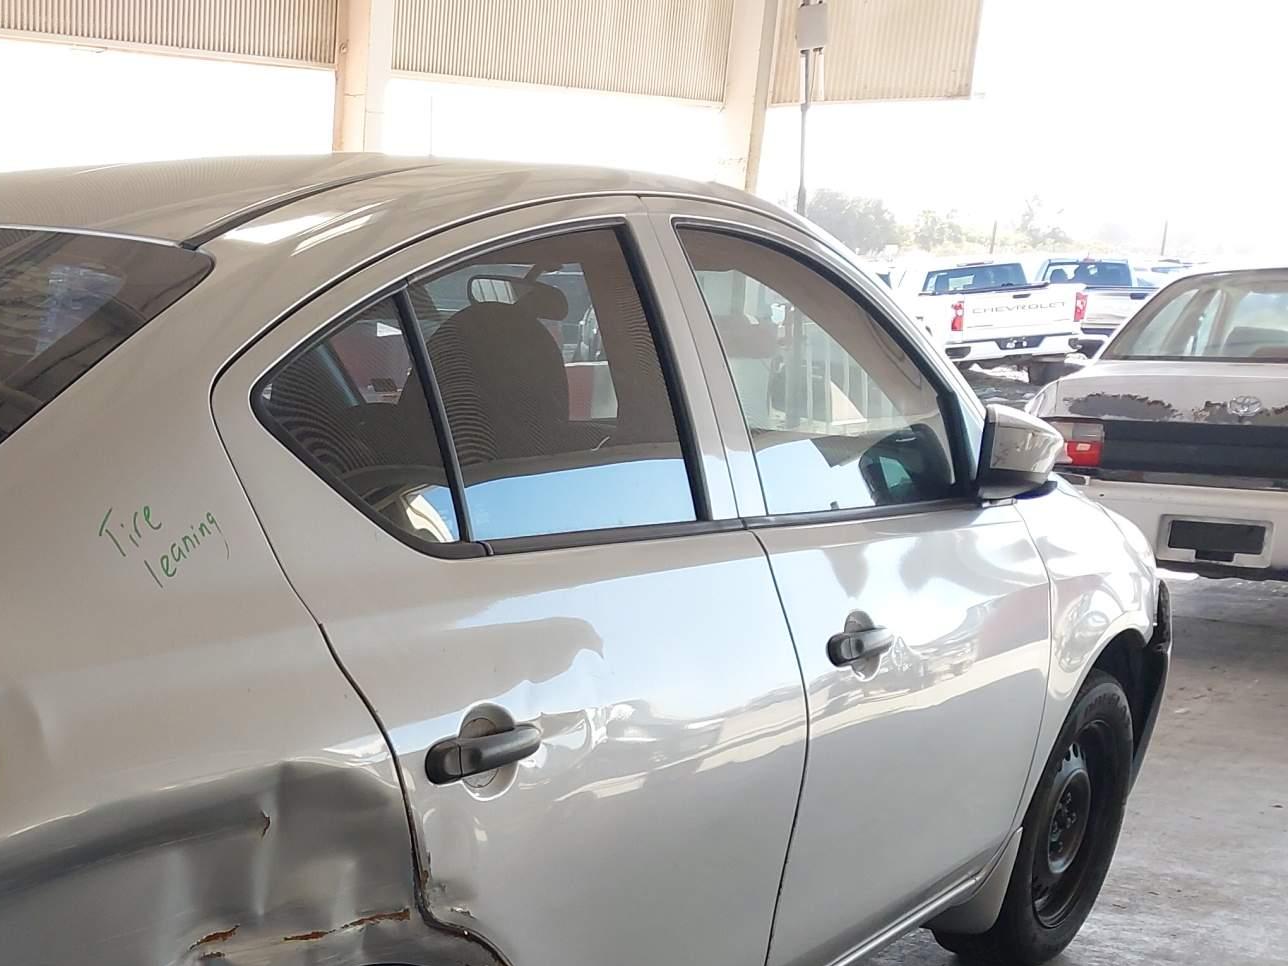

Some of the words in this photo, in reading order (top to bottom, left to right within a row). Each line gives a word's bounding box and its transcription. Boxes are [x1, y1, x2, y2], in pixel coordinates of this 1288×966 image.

[971, 300, 1066, 314] CHEVROLET
[99, 505, 162, 558] Tire
[144, 511, 230, 588] leaning
